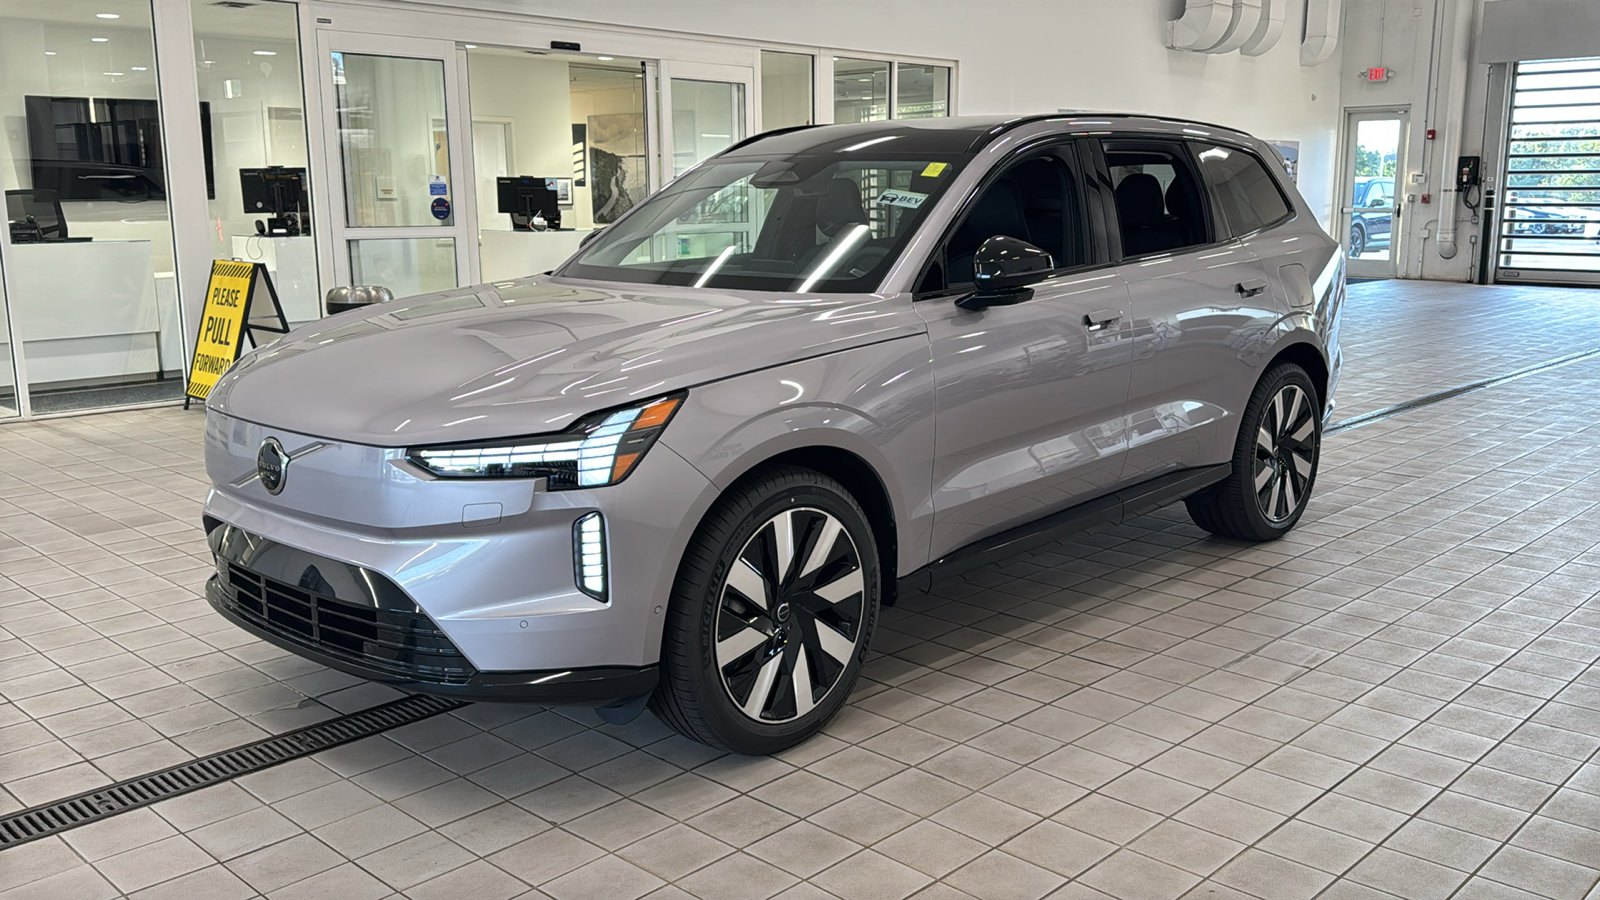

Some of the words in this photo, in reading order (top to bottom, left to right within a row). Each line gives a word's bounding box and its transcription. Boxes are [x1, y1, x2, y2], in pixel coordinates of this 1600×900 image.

[1369, 68, 1385, 80] EXIT
[899, 195, 923, 204] BEV
[212, 287, 240, 308] PLEASE
[204, 316, 231, 346] PULL
[702, 564, 724, 647] MICHELIN
